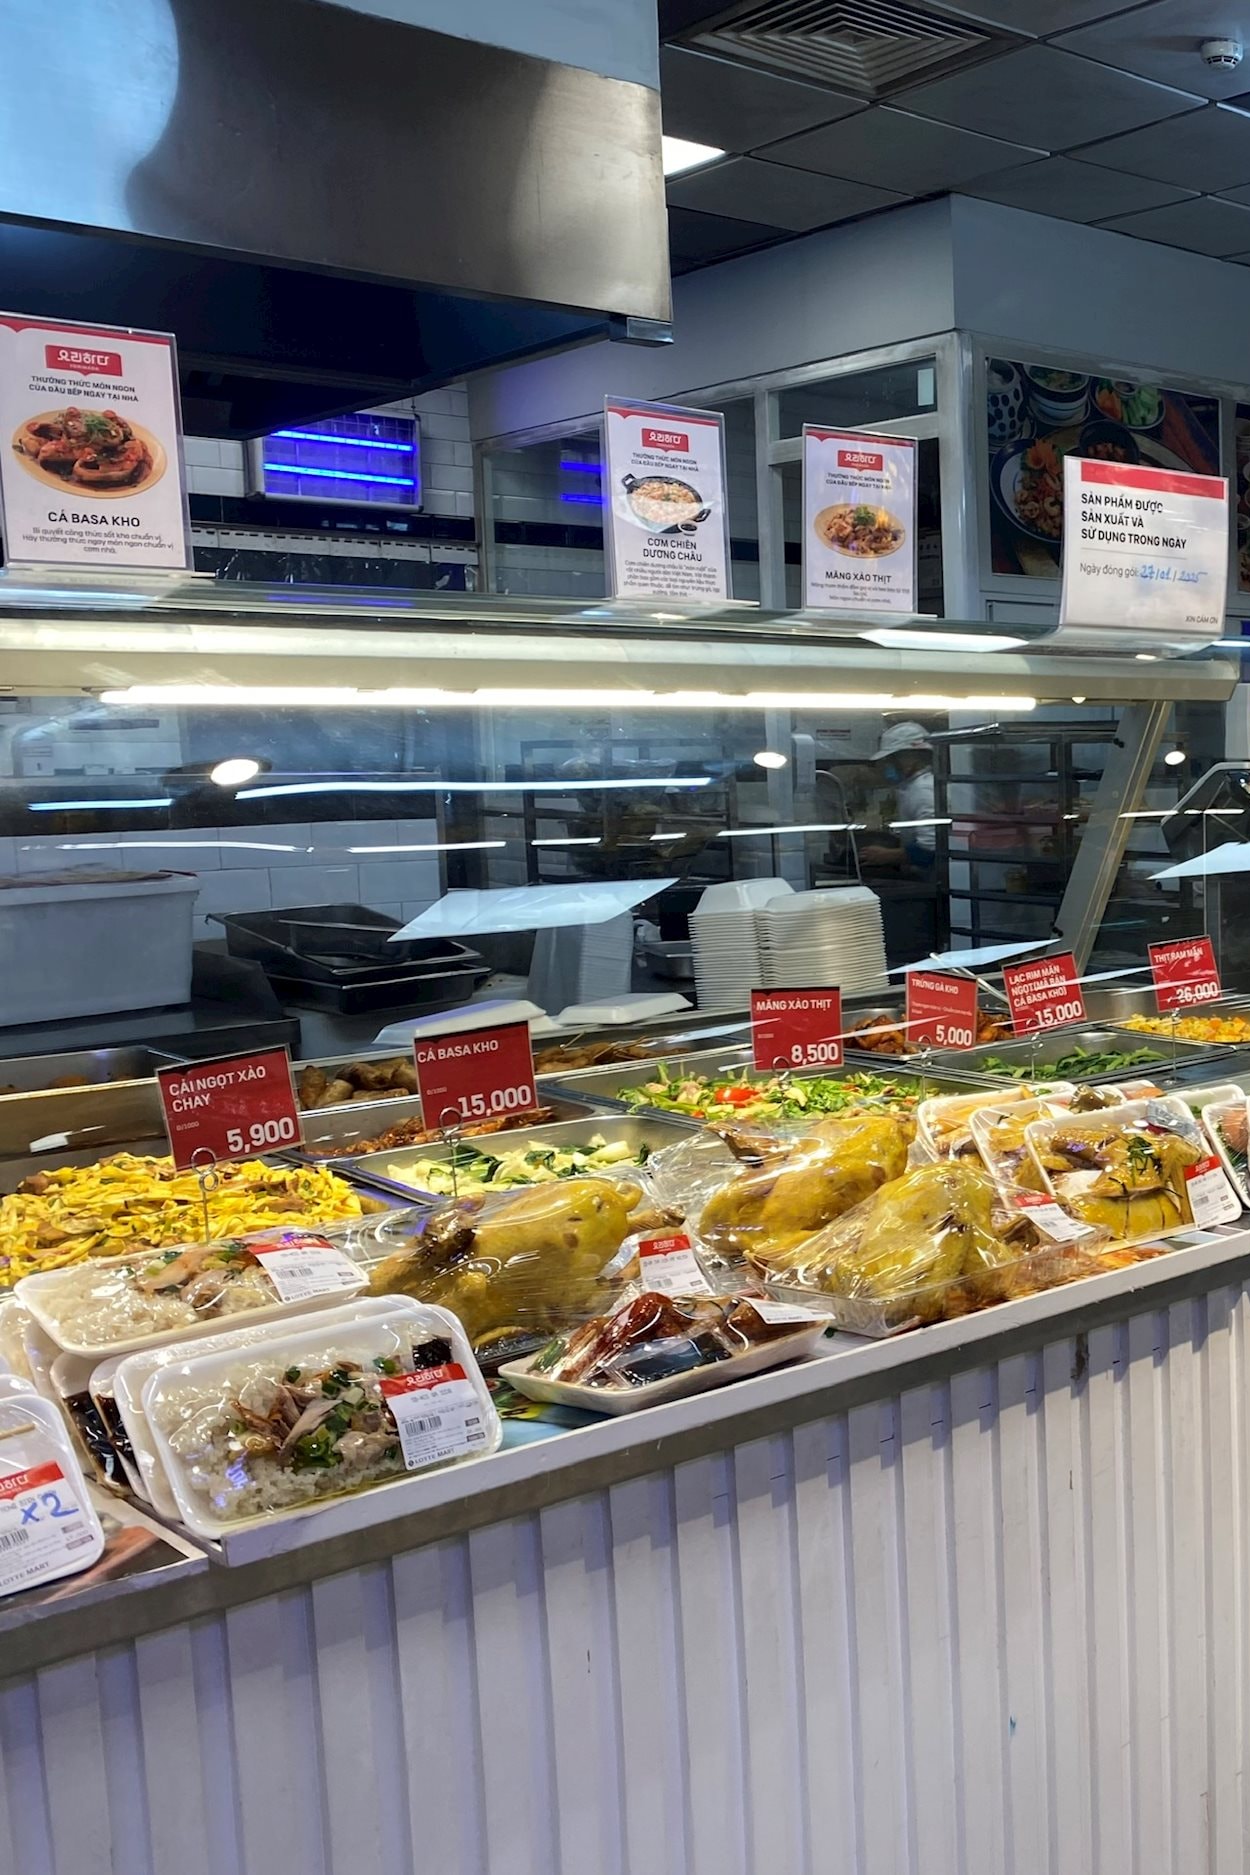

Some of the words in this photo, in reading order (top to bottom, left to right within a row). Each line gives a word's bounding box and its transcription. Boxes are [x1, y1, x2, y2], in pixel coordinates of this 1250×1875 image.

[57, 349, 110, 366] 요리하다
[1081, 491, 1102, 505] SẢN
[1104, 493, 1133, 509] PHẨM
[1135, 500, 1163, 515] ĐƯỢC
[47, 509, 68, 523] CÁ
[71, 513, 109, 526] BASA
[111, 516, 140, 528] KHO
[1081, 508, 1102, 523] SẢN
[1104, 512, 1130, 527] XUẤT
[1131, 515, 1144, 528] VÀ
[647, 538, 668, 548] CƠM
[670, 539, 697, 550] CHIÊN
[1081, 528, 1097, 540] SỬ
[1098, 530, 1126, 544] DỤNG
[1128, 533, 1160, 547] TRONG
[1162, 536, 1187, 549] NGÀY
[643, 548, 676, 560] DƯƠNG
[677, 550, 703, 562] CHÂU
[825, 570, 851, 581] MĂNG
[872, 574, 892, 585] THỊT
[1080, 563, 1101, 575] Ngày
[1103, 564, 1123, 578] đóng
[911, 978, 934, 991] TRỨNG
[934, 981, 944, 992] GÀ
[945, 984, 959, 994] KHO
[1009, 973, 1026, 985] LẠC
[1025, 969, 1041, 980] RIM
[756, 999, 787, 1011] MĂNG
[788, 997, 809, 1010] XÀO
[810, 999, 833, 1011] THỊT
[1026, 992, 1048, 1004] BASA
[1035, 1000, 1082, 1025] 15,000
[936, 1024, 972, 1046] 5,000
[417, 1048, 436, 1063] CÁ
[437, 1044, 471, 1060] BASA
[473, 1040, 499, 1054] KHO
[791, 1042, 839, 1066] 8,500
[169, 1079, 195, 1096] CẢI
[196, 1072, 235, 1090] NGỌT
[237, 1065, 266, 1082] XÀO
[172, 1093, 211, 1113] CHAY
[457, 1084, 532, 1118] 15,000
[226, 1116, 295, 1153] 5,900
[415, 1454, 437, 1464] LOTTE
[437, 1447, 455, 1457] MART
[26, 1561, 50, 1575] MART
